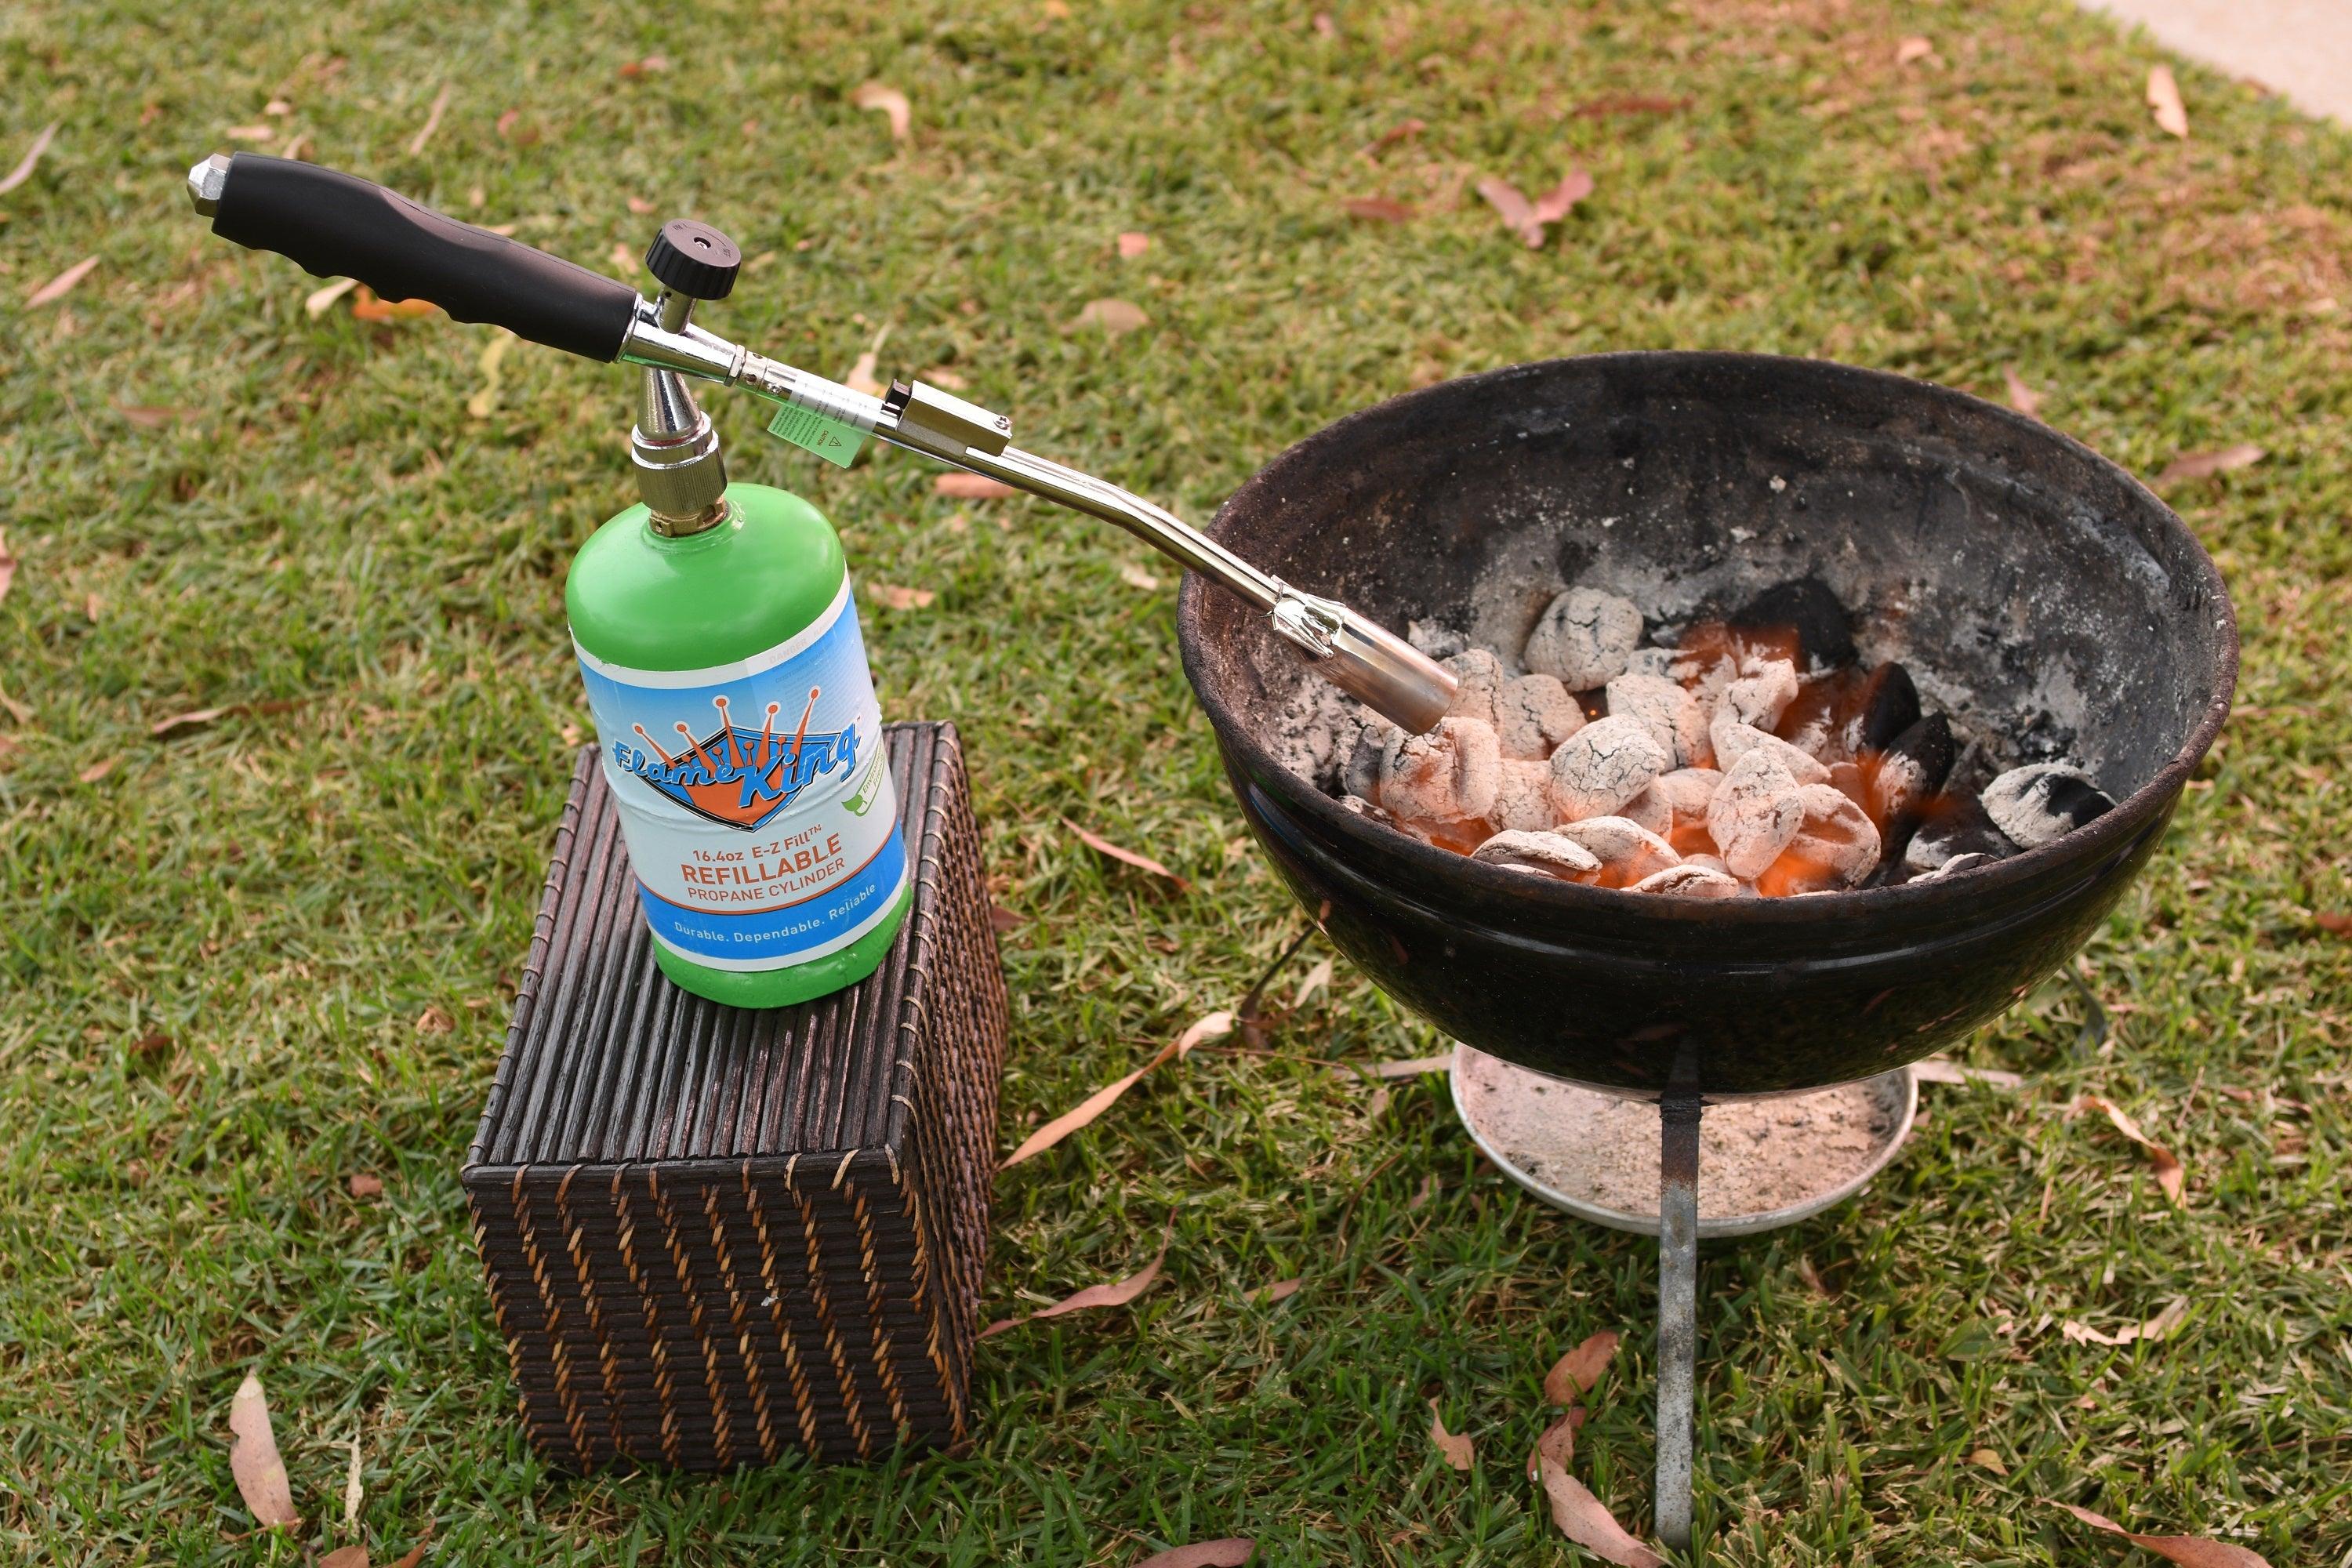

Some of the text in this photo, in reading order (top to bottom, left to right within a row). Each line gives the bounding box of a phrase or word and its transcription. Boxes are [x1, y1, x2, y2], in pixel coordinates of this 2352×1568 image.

[612, 722, 861, 808] Flame King
[681, 832, 842, 885] REFILLABLE
[693, 850, 744, 862] 16.4oz
[752, 841, 781, 858] E-Z
[688, 857, 845, 902] PROPANE CYLINDER
[674, 883, 877, 944] Durable. Dependable. Reliable
